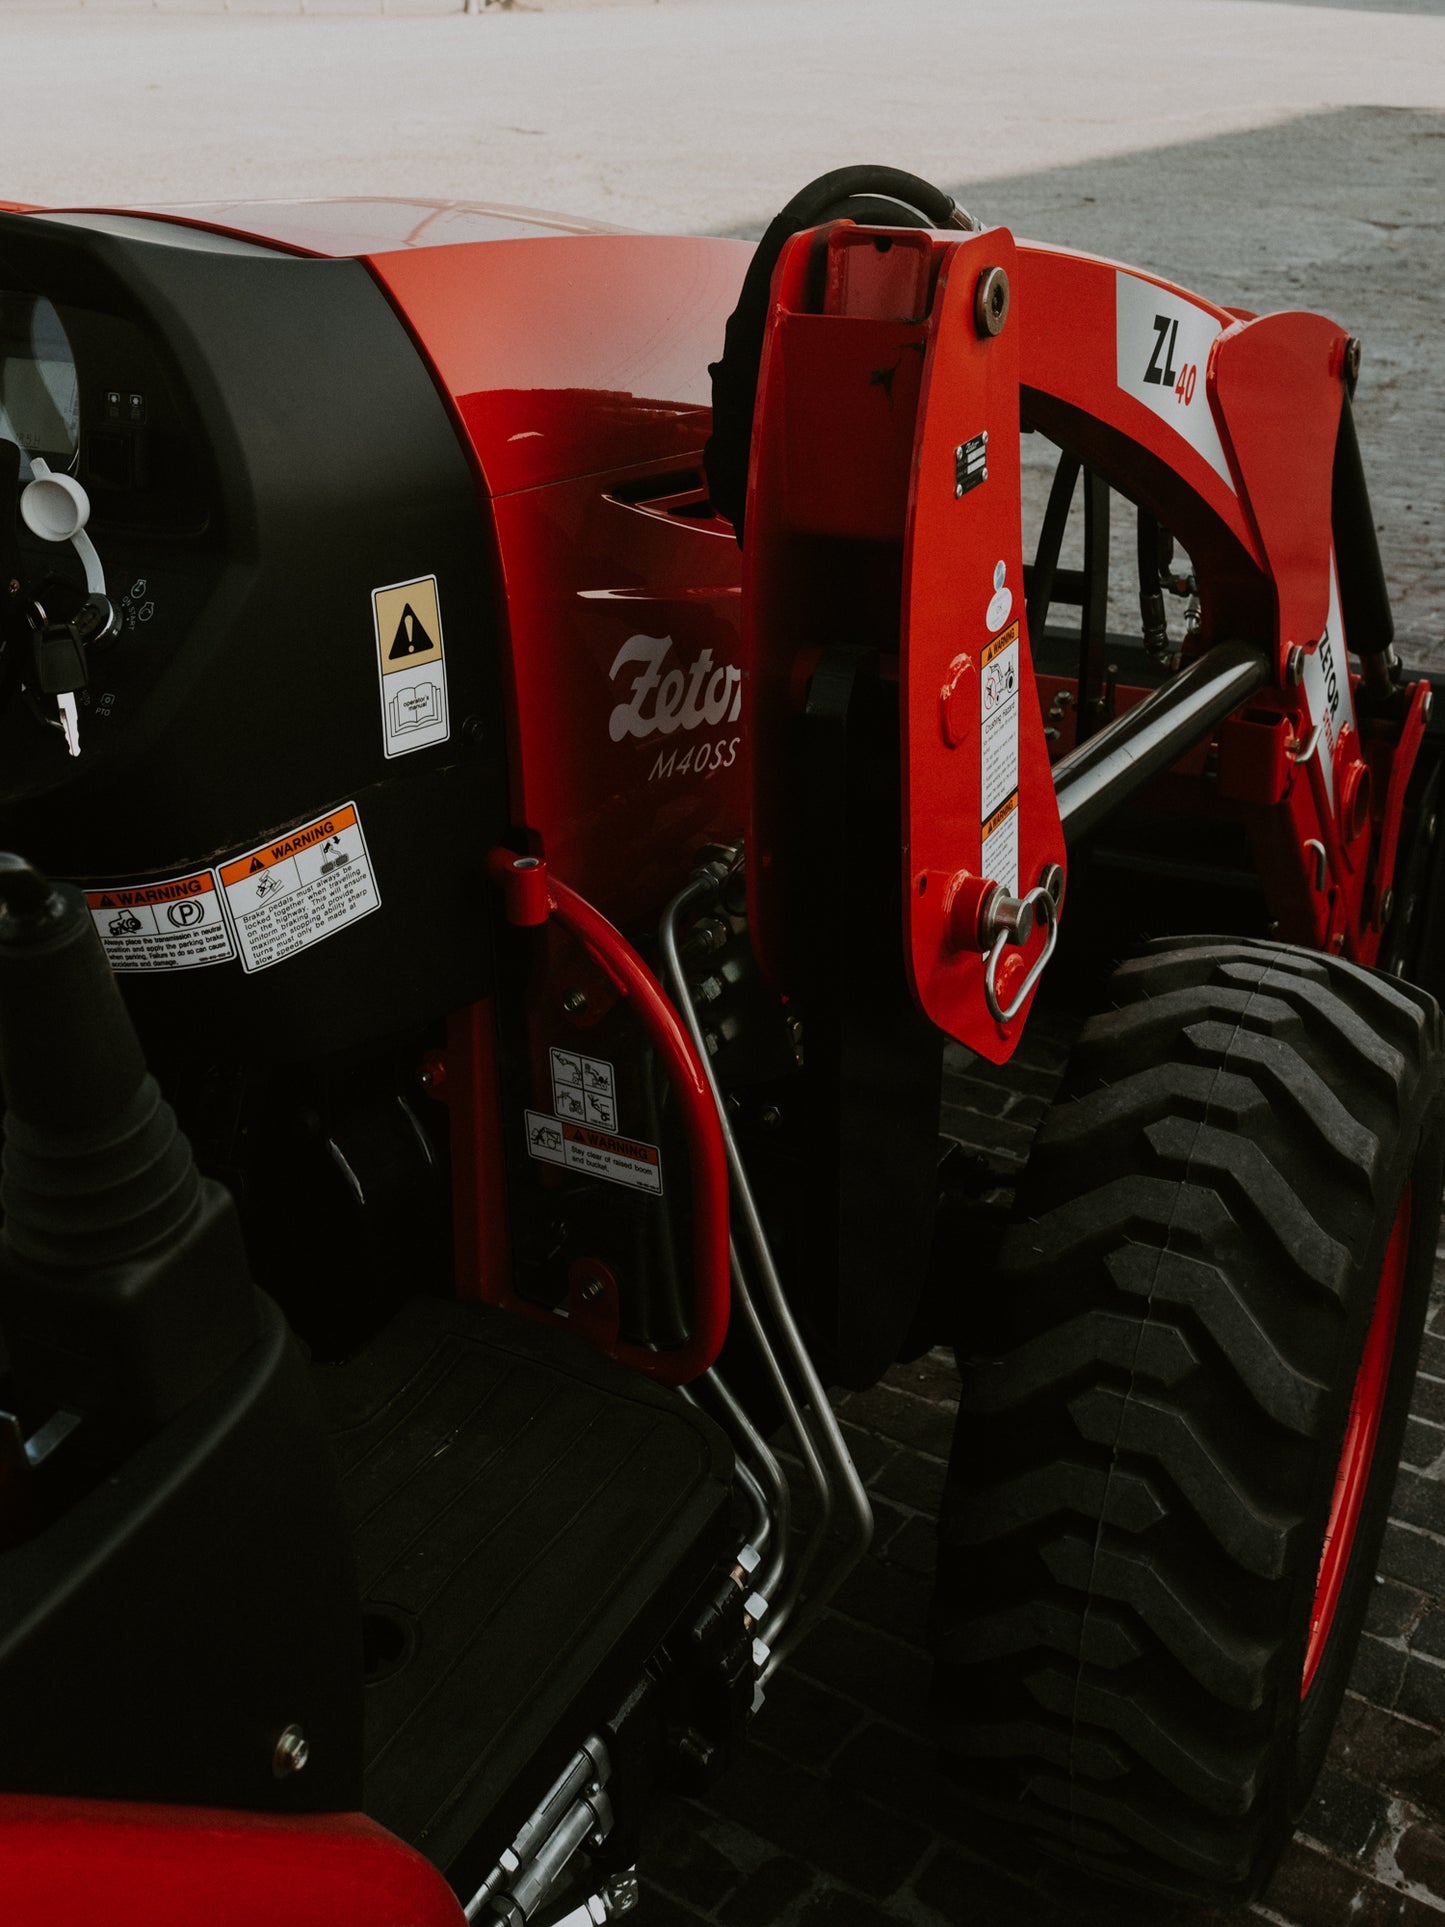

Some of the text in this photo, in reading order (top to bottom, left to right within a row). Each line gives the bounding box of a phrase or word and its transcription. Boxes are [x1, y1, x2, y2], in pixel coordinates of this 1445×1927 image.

[1143, 314, 1197, 406] ZL 40
[993, 627, 1015, 655] WARNING
[609, 634, 742, 743] Zetor
[1319, 628, 1339, 721] ZETOR
[95, 707, 110, 717] PTO
[648, 737, 741, 782] M40SS
[993, 800, 1013, 827] WARNING
[272, 821, 334, 860] WARNING
[117, 880, 202, 905] WARNING
[243, 865, 352, 924] Brake pedals must always be
[245, 868, 360, 930] locked together when travelling
[247, 930, 257, 938] on
[260, 922, 272, 932] the
[311, 895, 327, 905] This
[329, 887, 341, 896] will
[344, 873, 367, 889] ensure
[249, 889, 354, 945] uniform braking and provide
[251, 888, 367, 951] maximum stopping ability sharp
[253, 902, 356, 959] turns must only be made at
[125, 938, 142, 946] place
[154, 932, 191, 943] transmission
[201, 924, 221, 935] neutral
[146, 943, 163, 952] apply
[165, 941, 176, 950] the
[179, 937, 203, 949] parking
[205, 934, 224, 943] brake
[149, 951, 168, 960] Failure
[196, 945, 207, 954] can
[208, 941, 226, 951] cause
[276, 939, 303, 957] speeds
[140, 960, 151, 968] and
[572, 1156, 584, 1164] and
[572, 1145, 584, 1157] Stay
[587, 1151, 603, 1161] clear
[613, 1159, 632, 1170] raised
[634, 1165, 653, 1176] boom
[587, 1132, 648, 1160] WARNING
